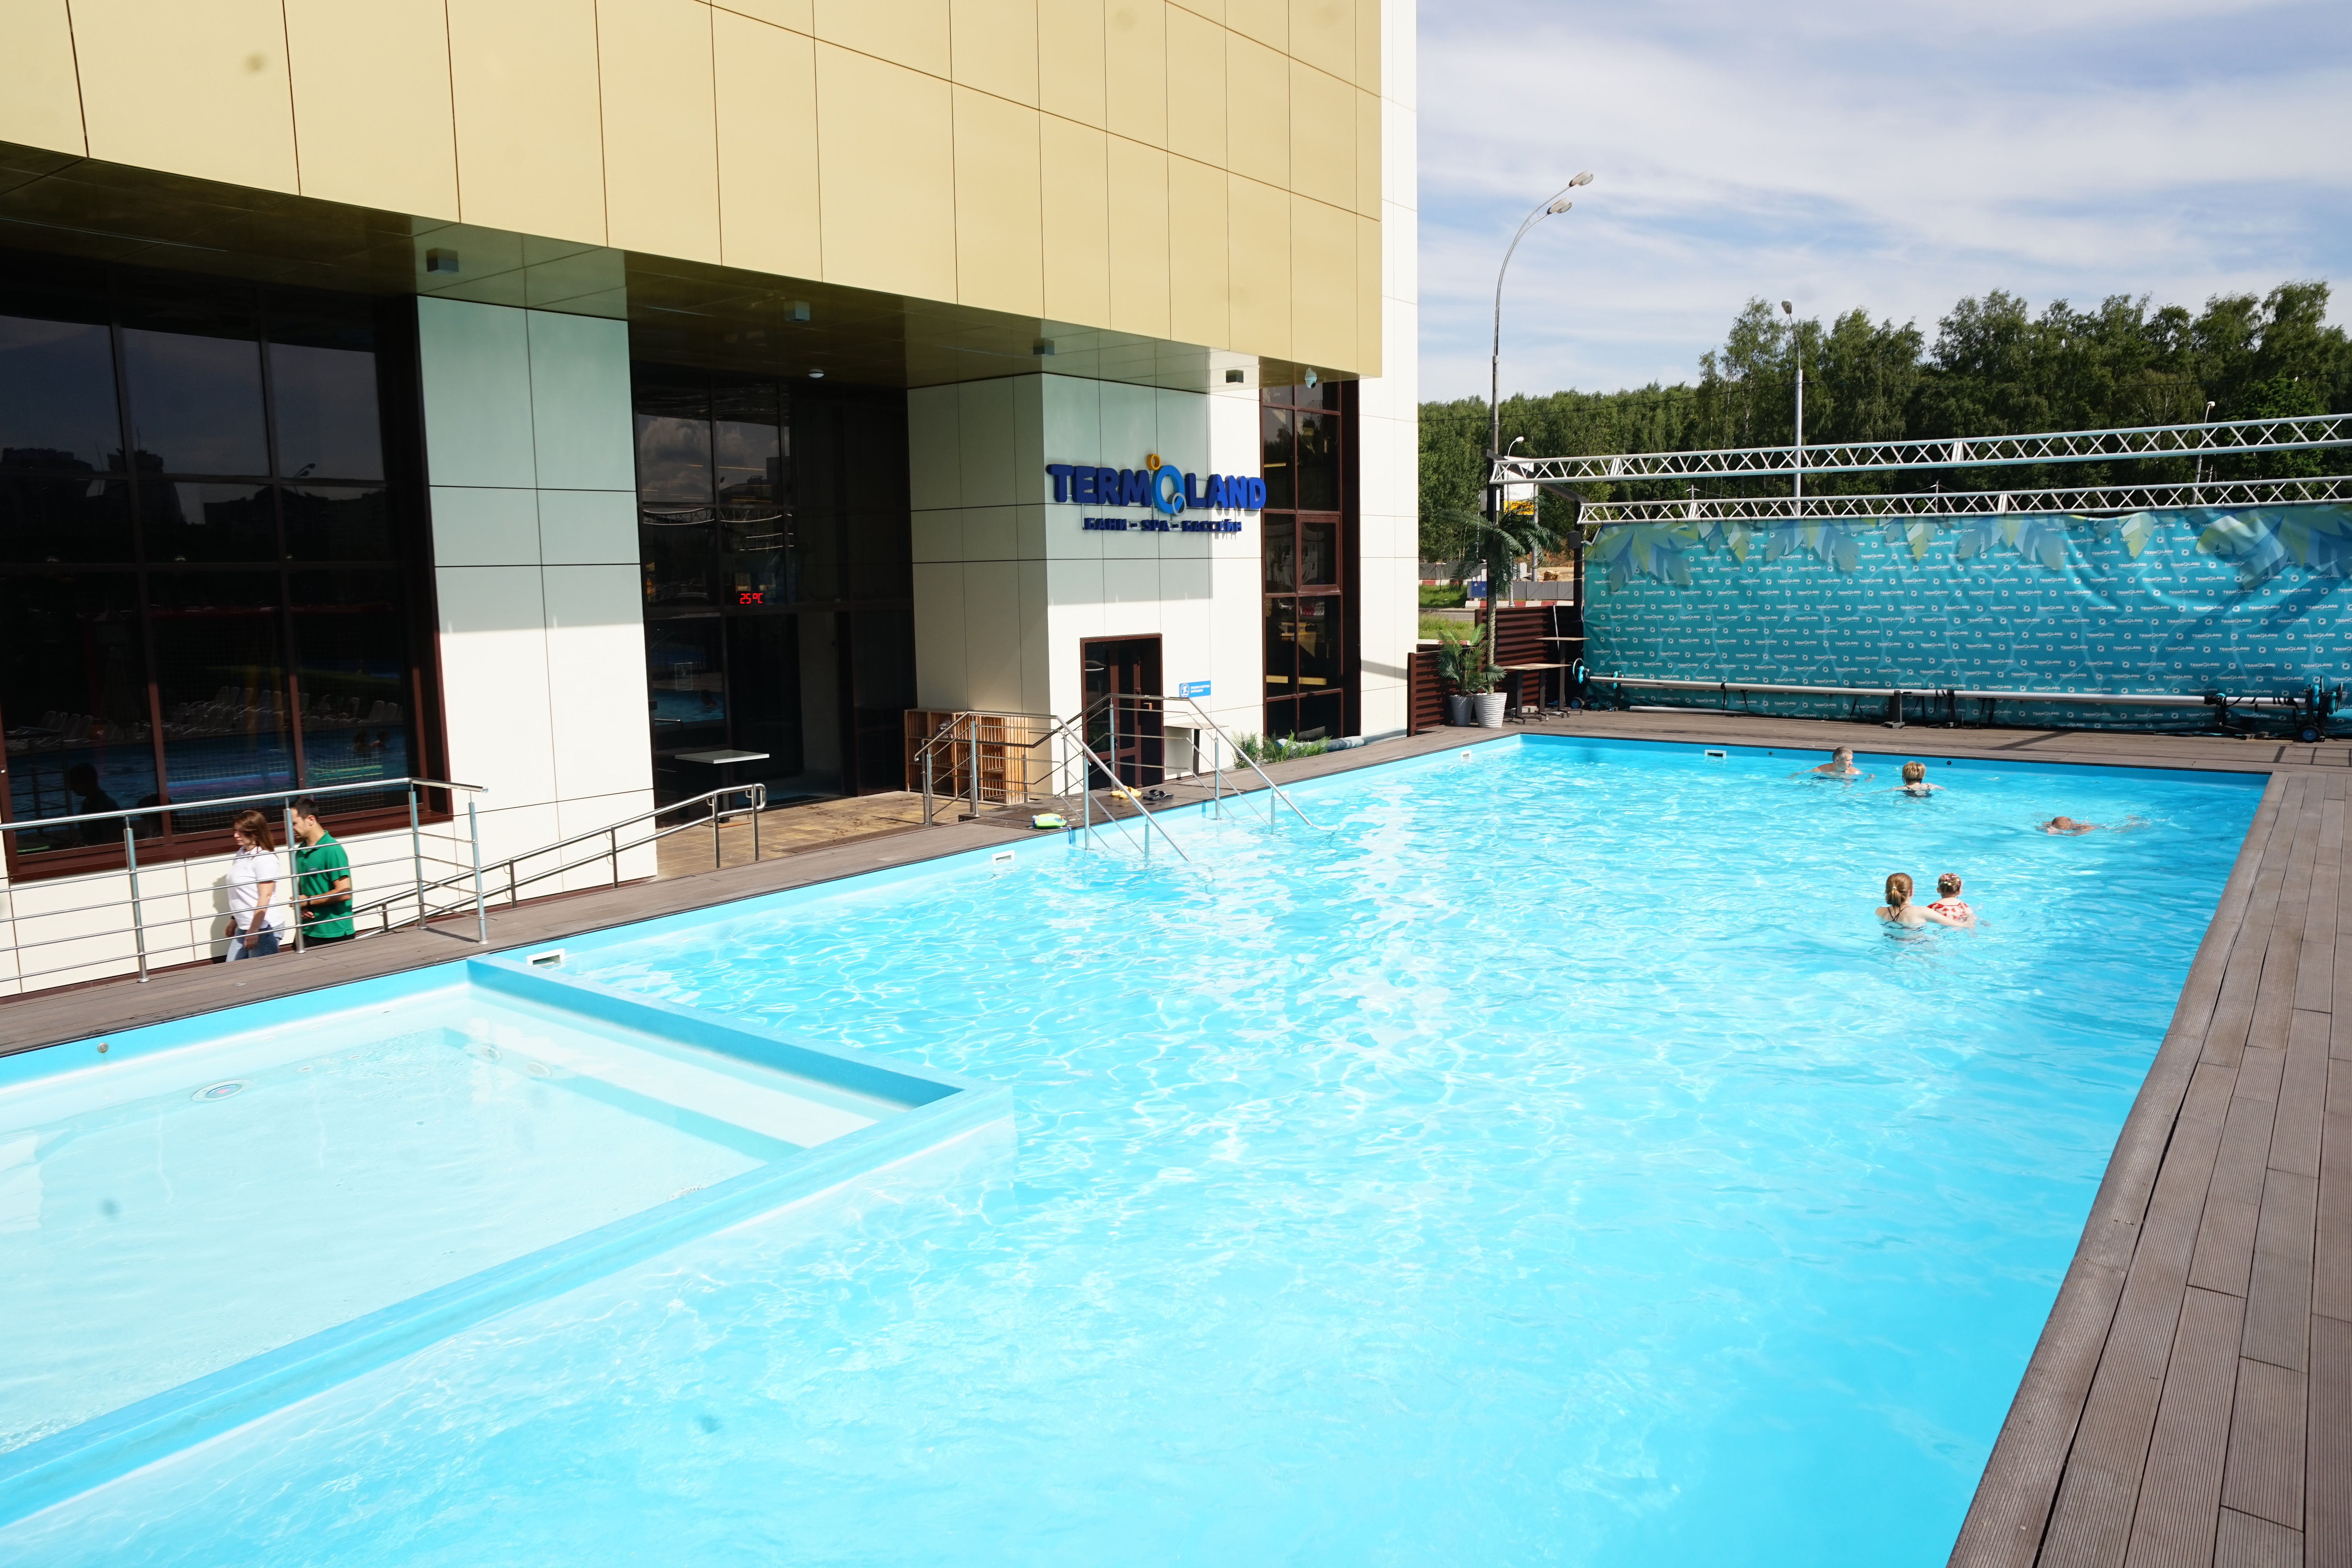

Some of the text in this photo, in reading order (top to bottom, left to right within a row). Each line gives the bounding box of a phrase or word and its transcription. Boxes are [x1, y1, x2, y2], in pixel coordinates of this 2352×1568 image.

[1046, 463, 1266, 514] TERMOLAND
[1084, 518, 1127, 530] БАНИ
[1141, 519, 1170, 531] SPA
[1182, 519, 1242, 532] БАССЕЙН
